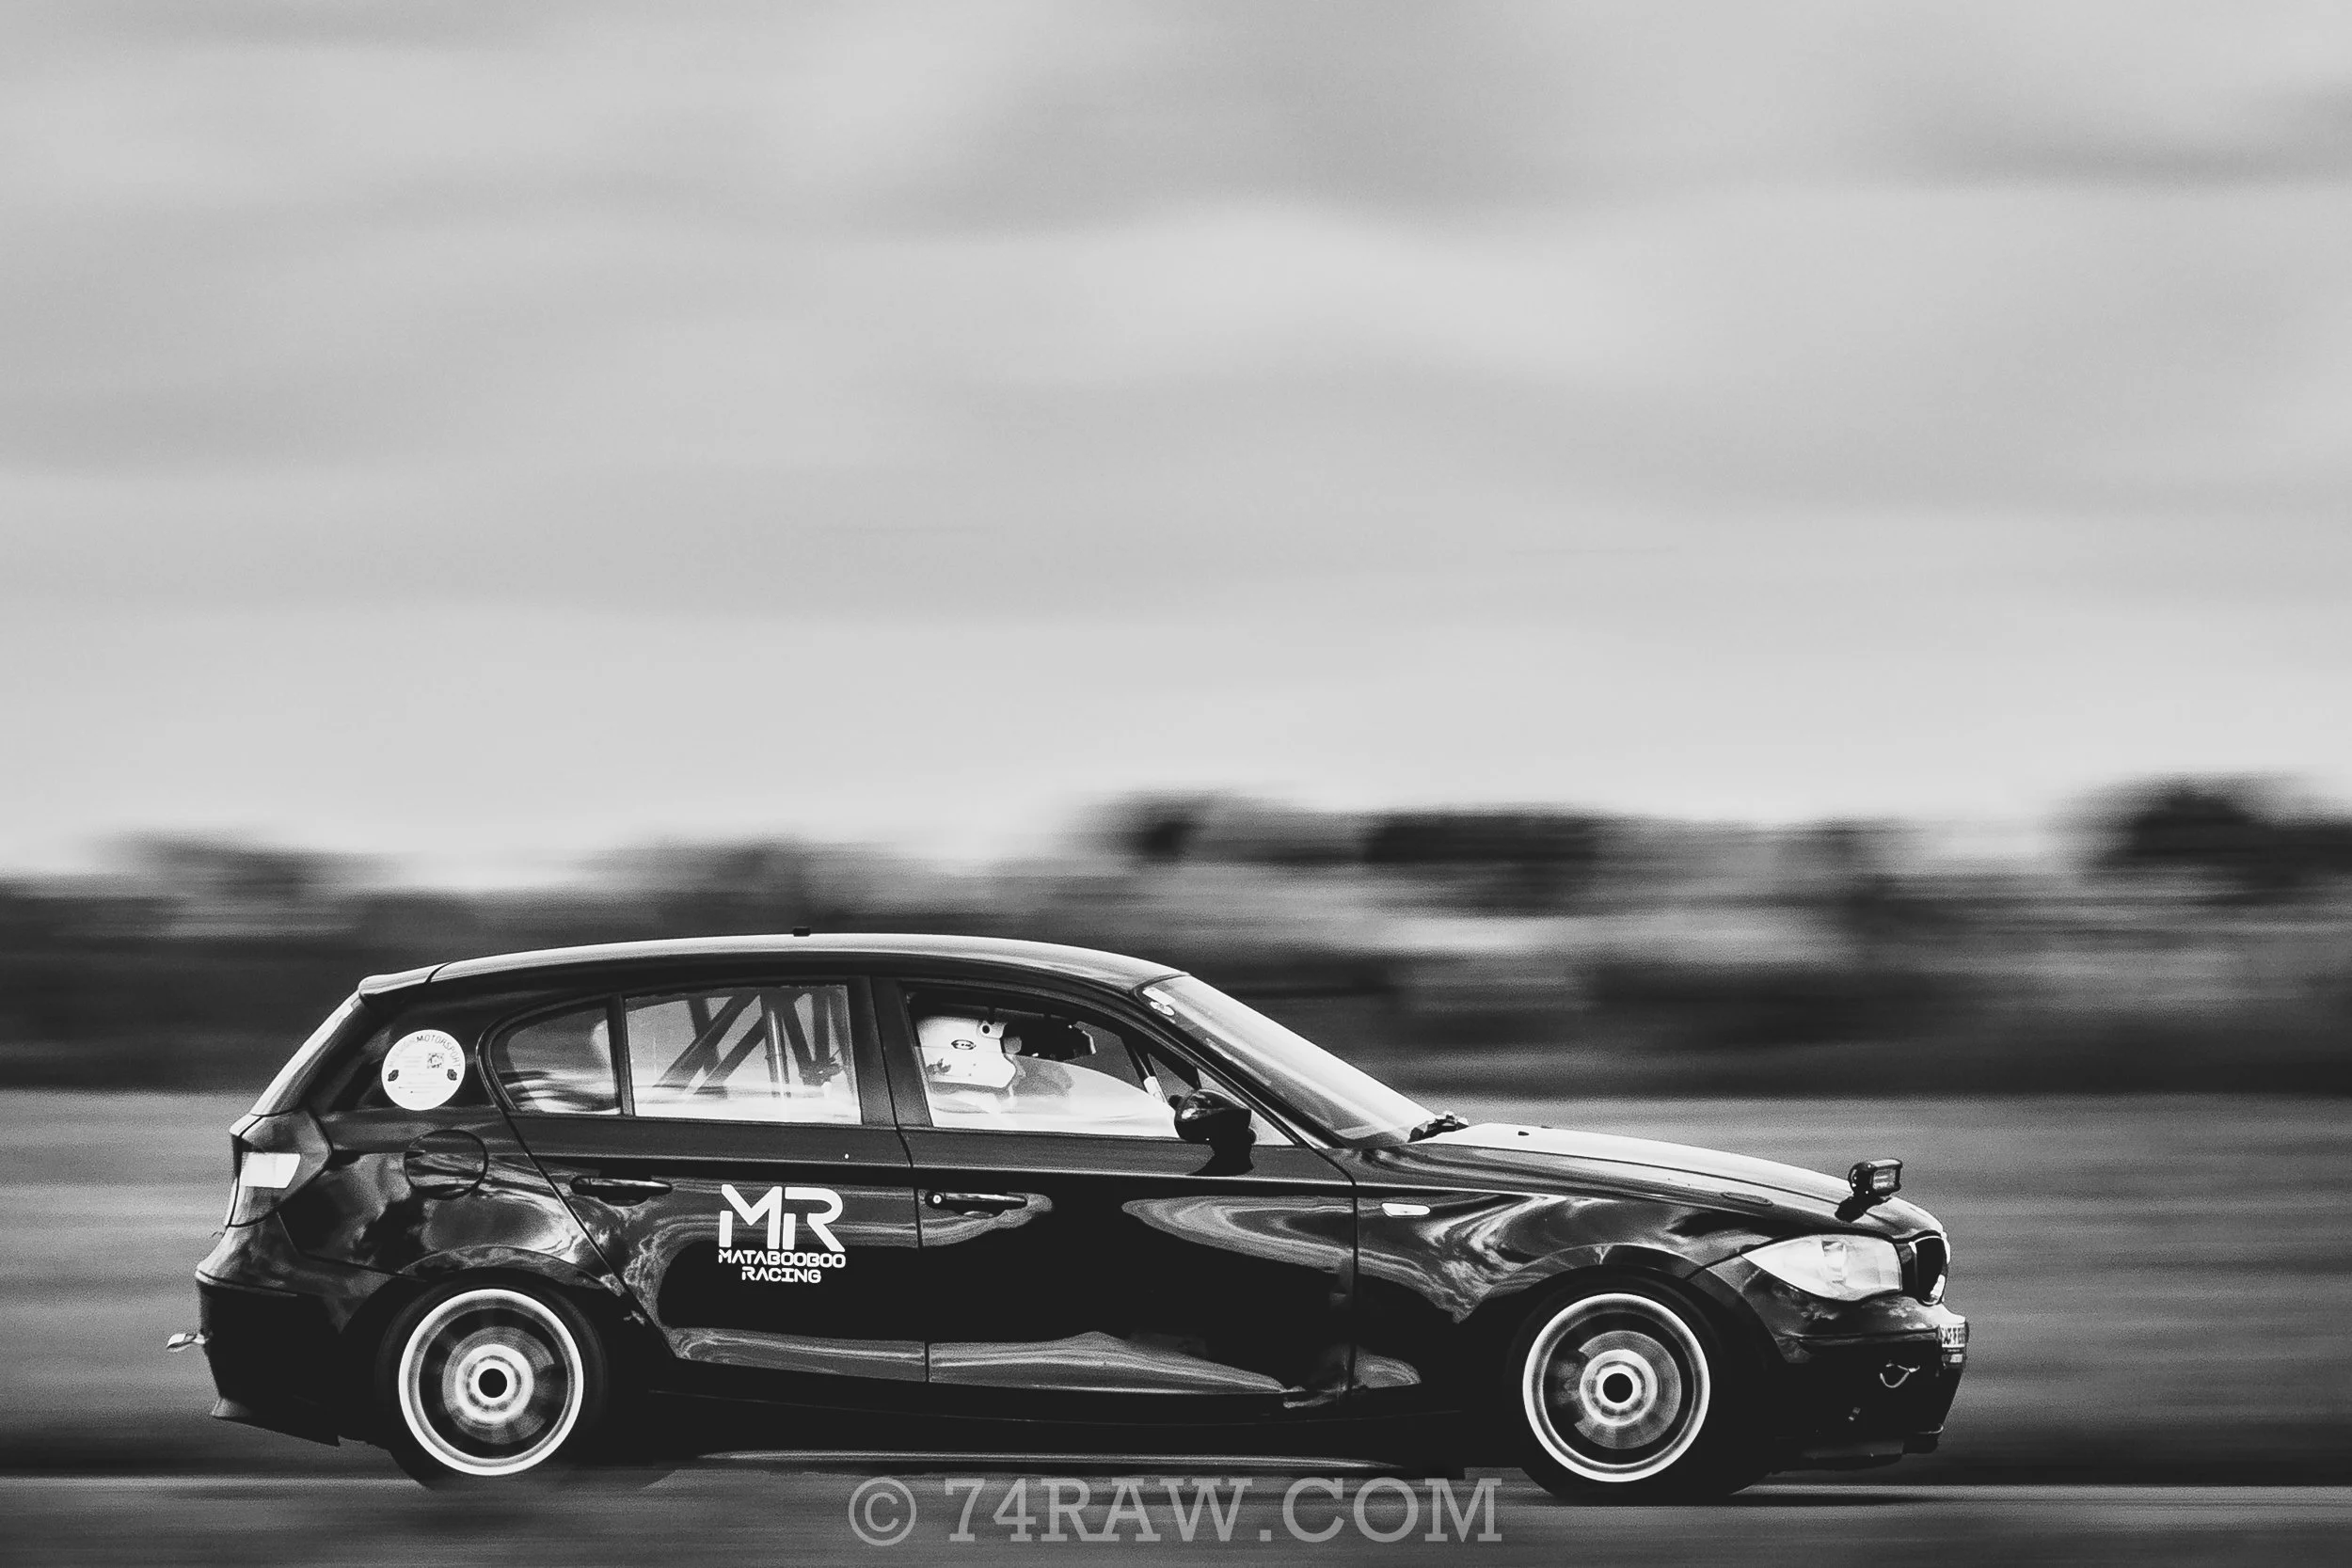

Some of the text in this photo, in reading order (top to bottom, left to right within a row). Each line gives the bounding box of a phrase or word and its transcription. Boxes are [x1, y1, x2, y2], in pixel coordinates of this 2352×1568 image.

[416, 1034, 461, 1068] MOTORSPORT
[719, 1184, 846, 1252] MR
[718, 1249, 846, 1268] MATABOOBOO
[741, 1266, 821, 1283] RACING
